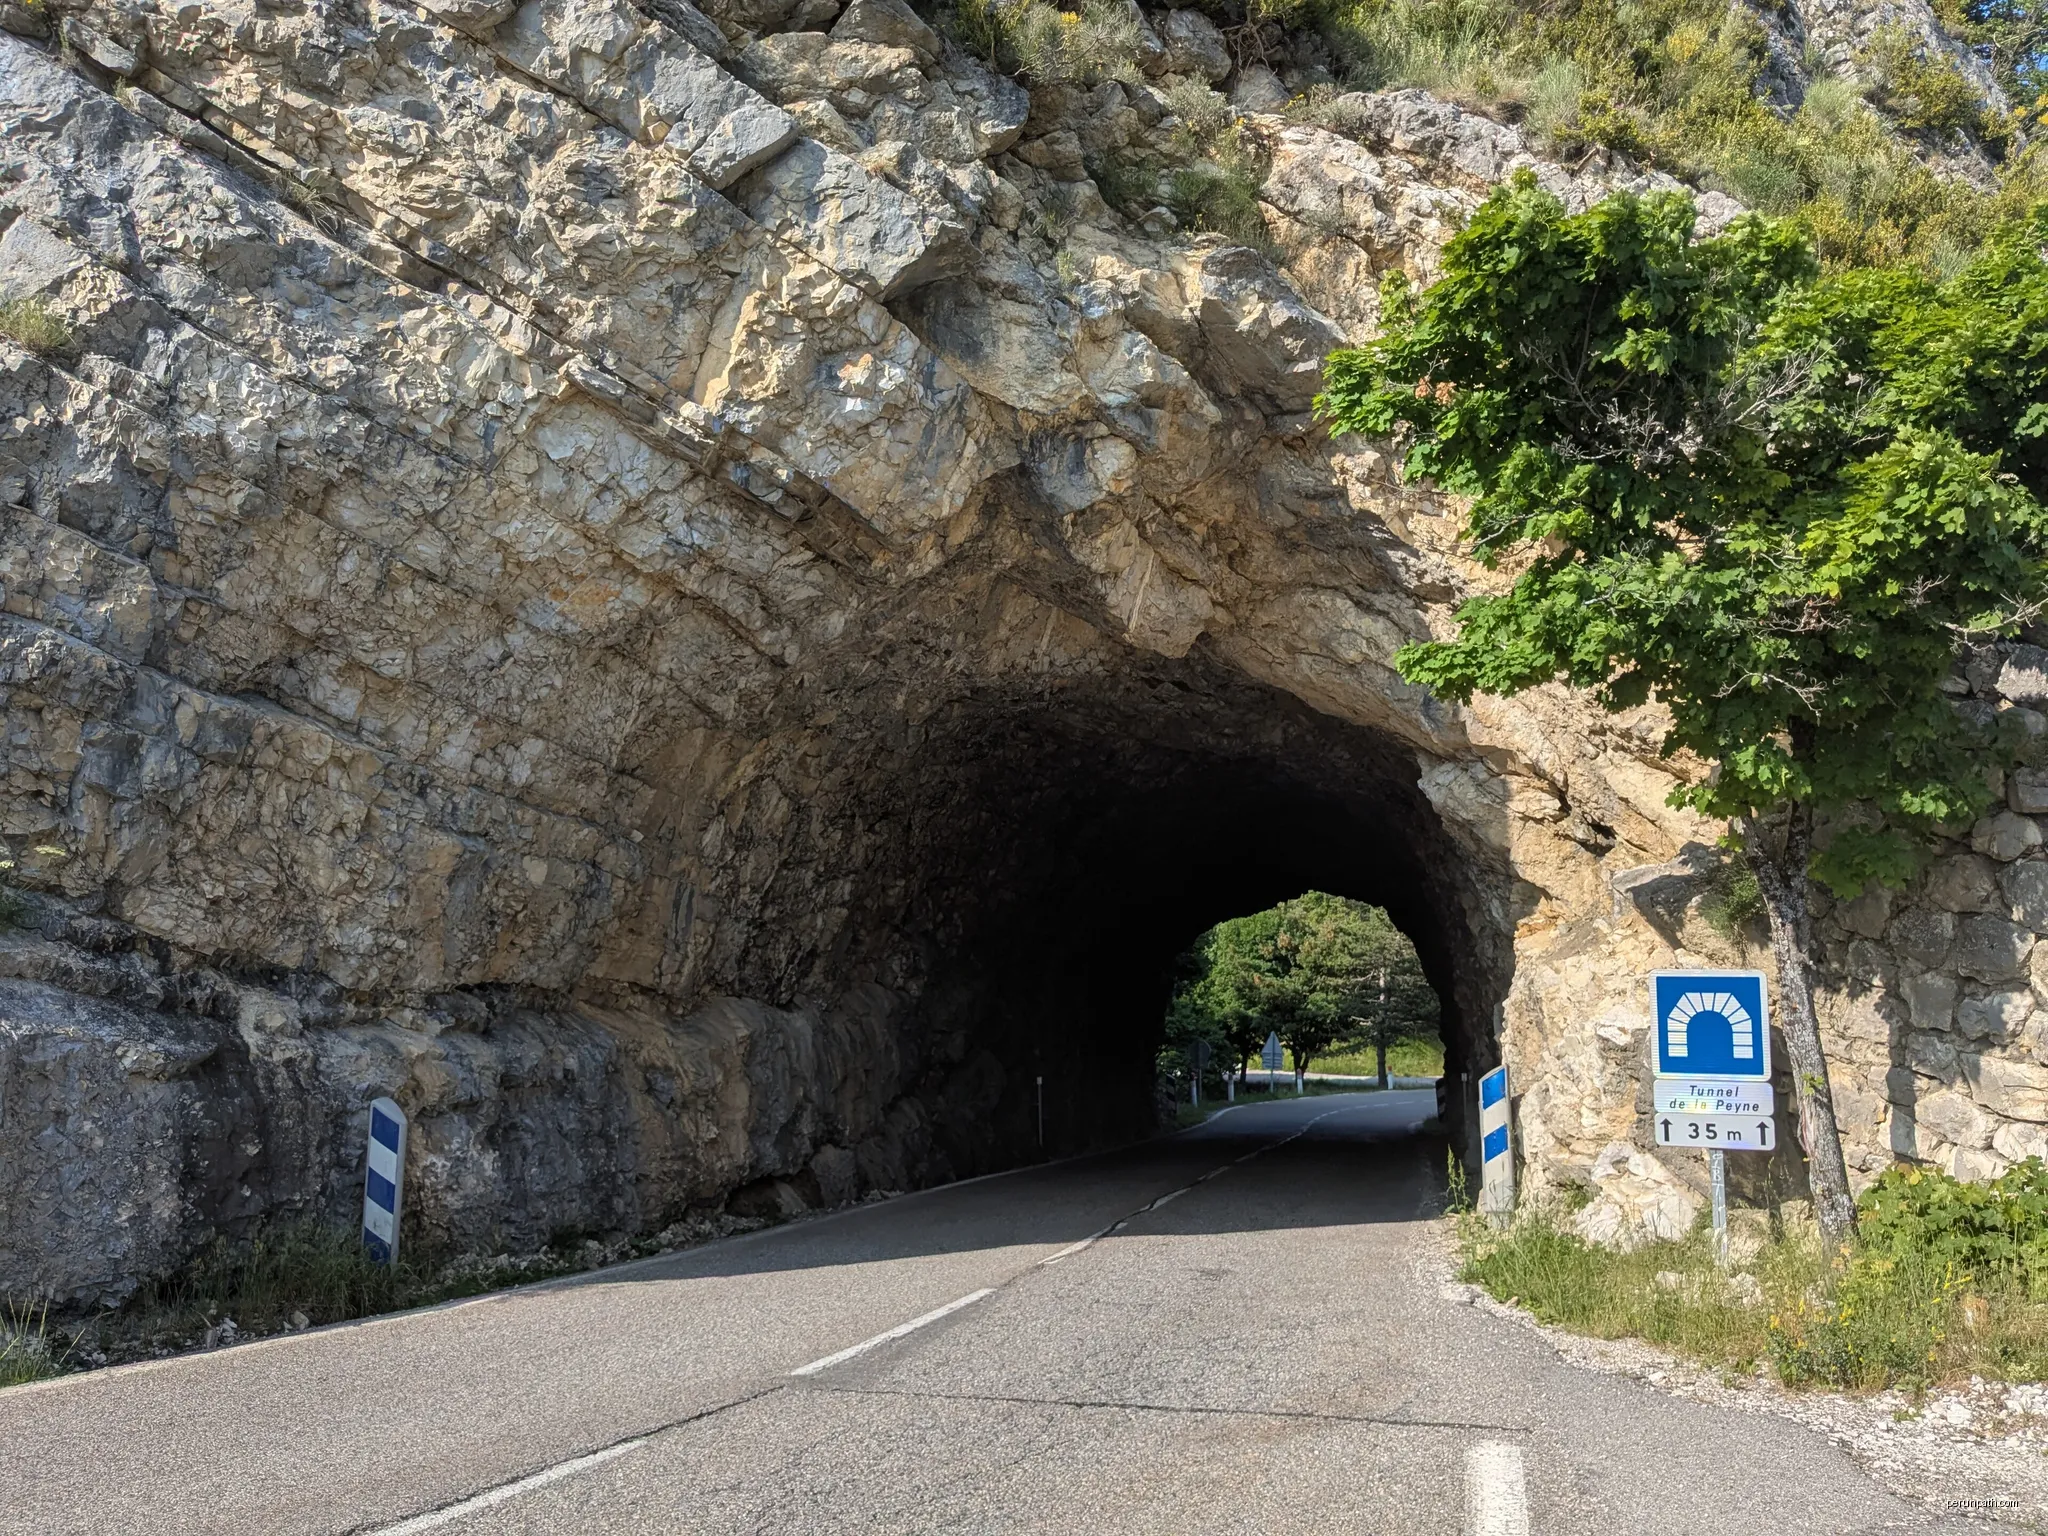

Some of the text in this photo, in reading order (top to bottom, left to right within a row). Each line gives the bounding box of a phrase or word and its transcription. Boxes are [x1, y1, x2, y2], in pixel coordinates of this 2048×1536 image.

[1689, 1085, 1739, 1097] Tunnel
[1669, 1098, 1760, 1113] de la Peyne
[1688, 1122, 1742, 1141] 35 m
